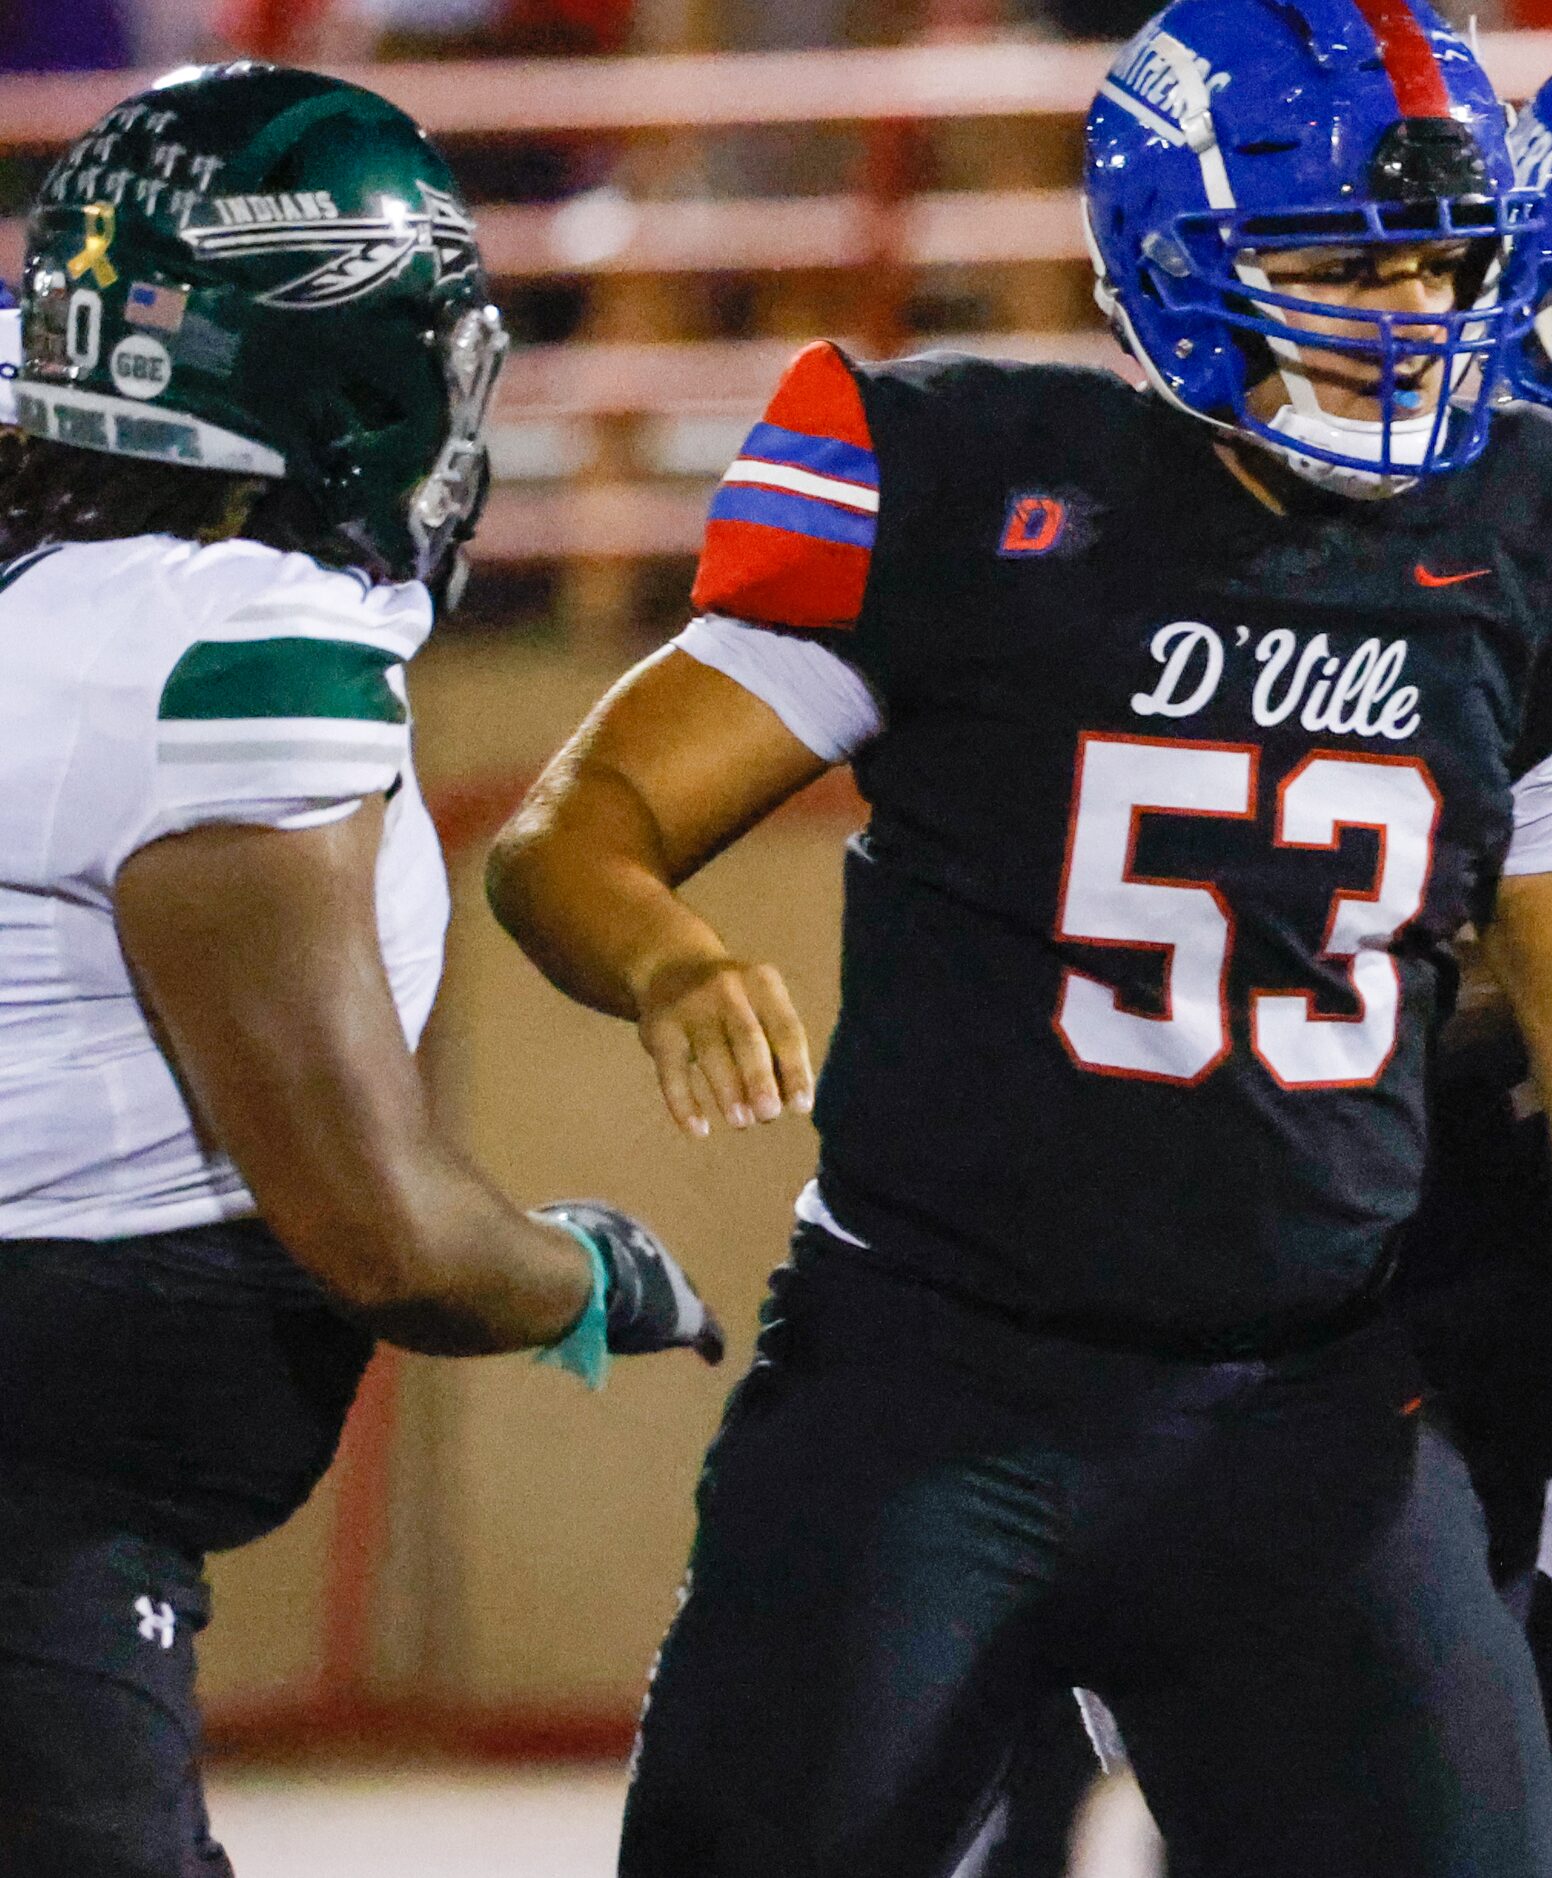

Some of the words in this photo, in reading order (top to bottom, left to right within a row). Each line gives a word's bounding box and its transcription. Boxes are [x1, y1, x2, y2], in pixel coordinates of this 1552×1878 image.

[213, 190, 339, 226] INDIANS
[115, 351, 164, 383] GBE
[1130, 618, 1422, 741] D'Ville
[1051, 730, 1443, 1092] 53
